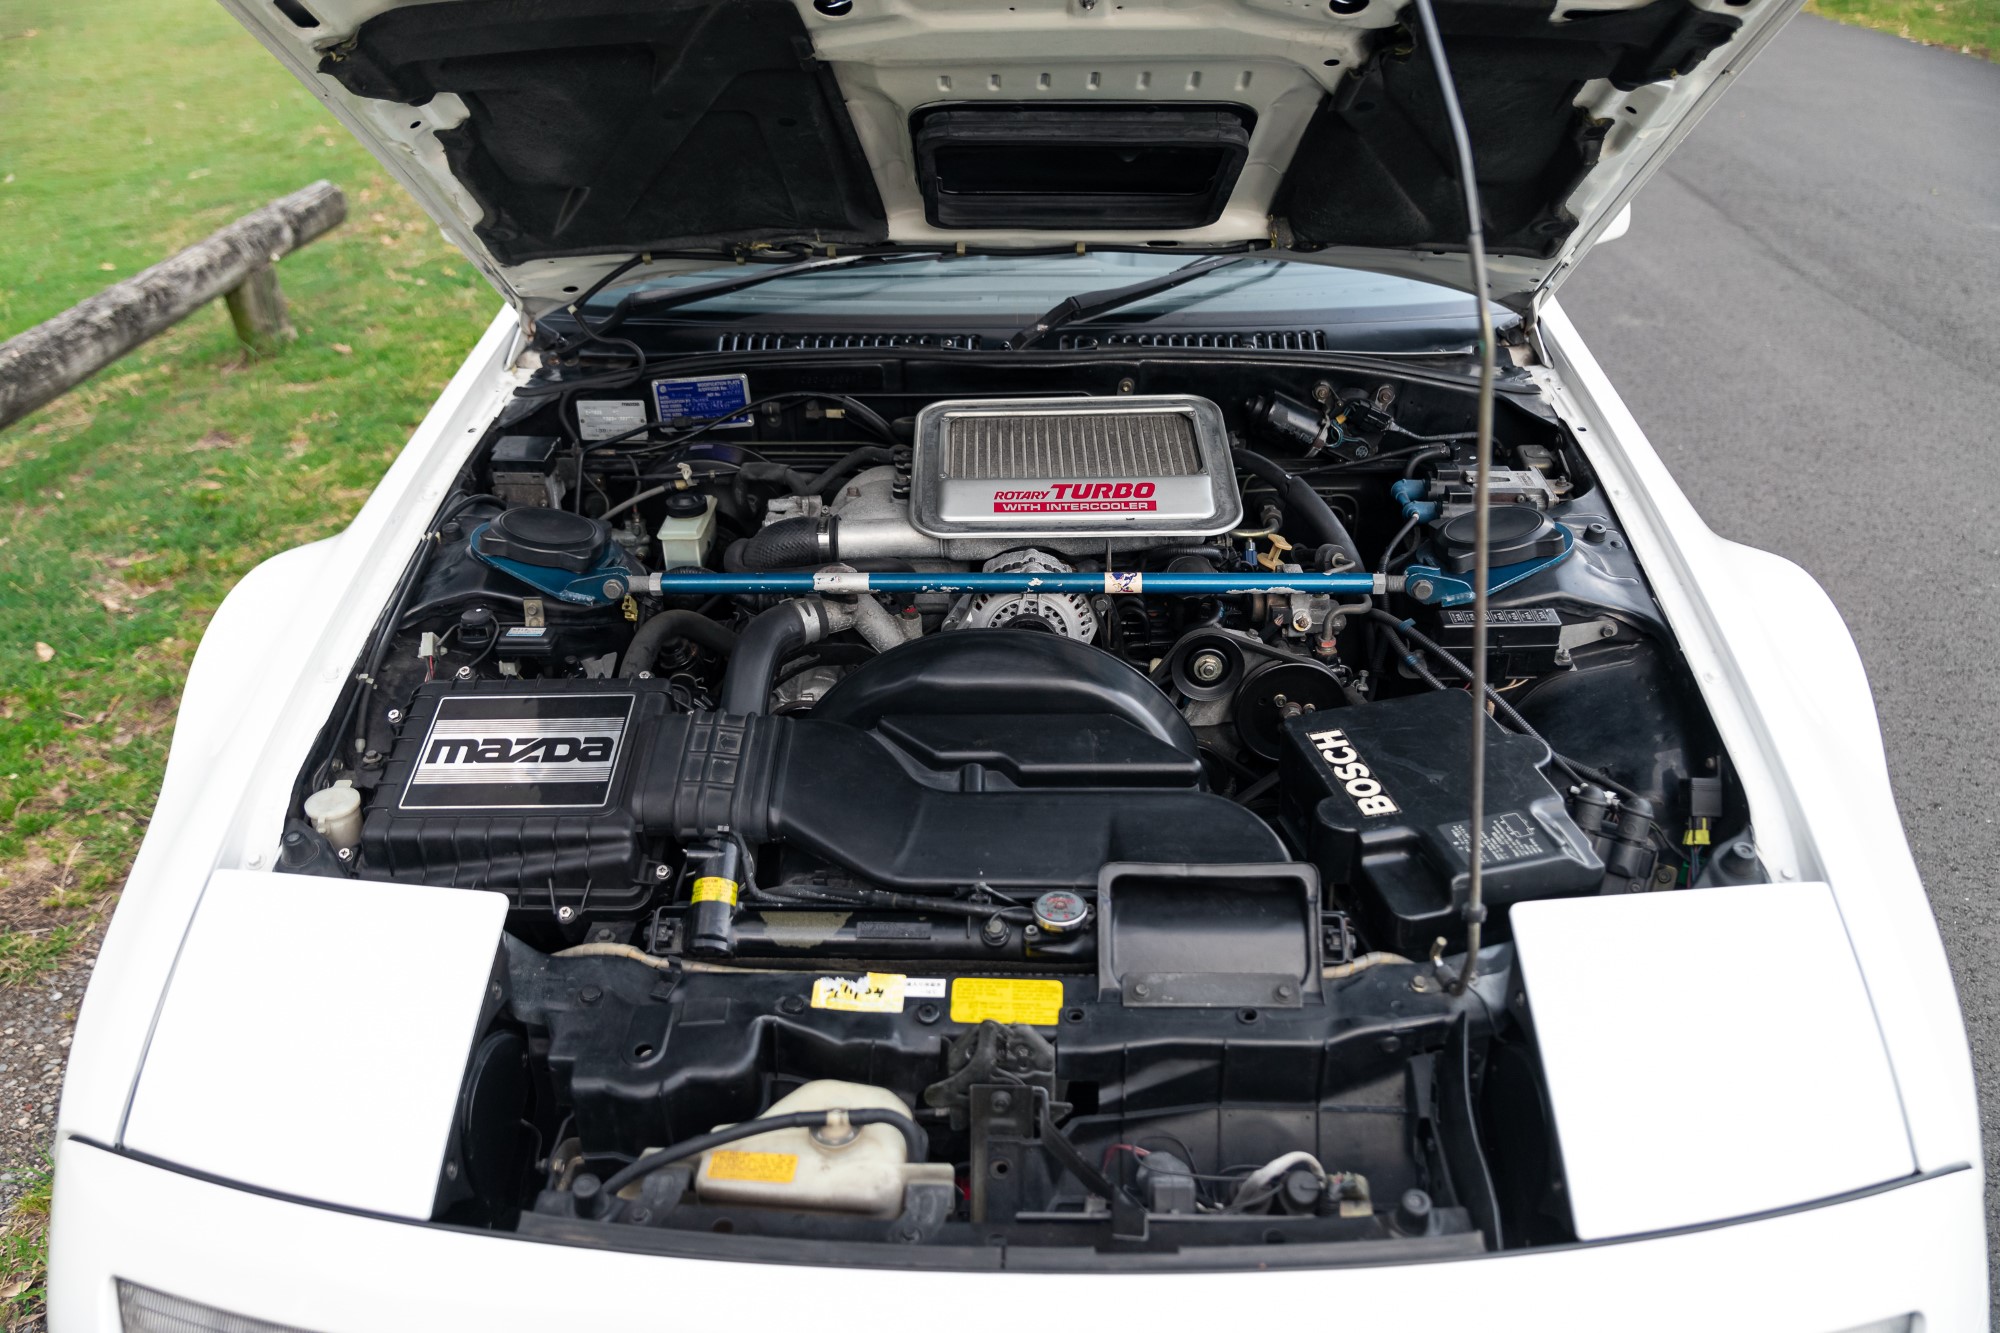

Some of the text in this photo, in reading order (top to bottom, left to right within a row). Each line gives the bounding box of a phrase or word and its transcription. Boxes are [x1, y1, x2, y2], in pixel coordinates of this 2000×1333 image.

[994, 482, 1156, 500] ROTARY TURBO
[1002, 502, 1149, 511] WITH INTERCOOLER
[1309, 730, 1398, 816] BOSCH
